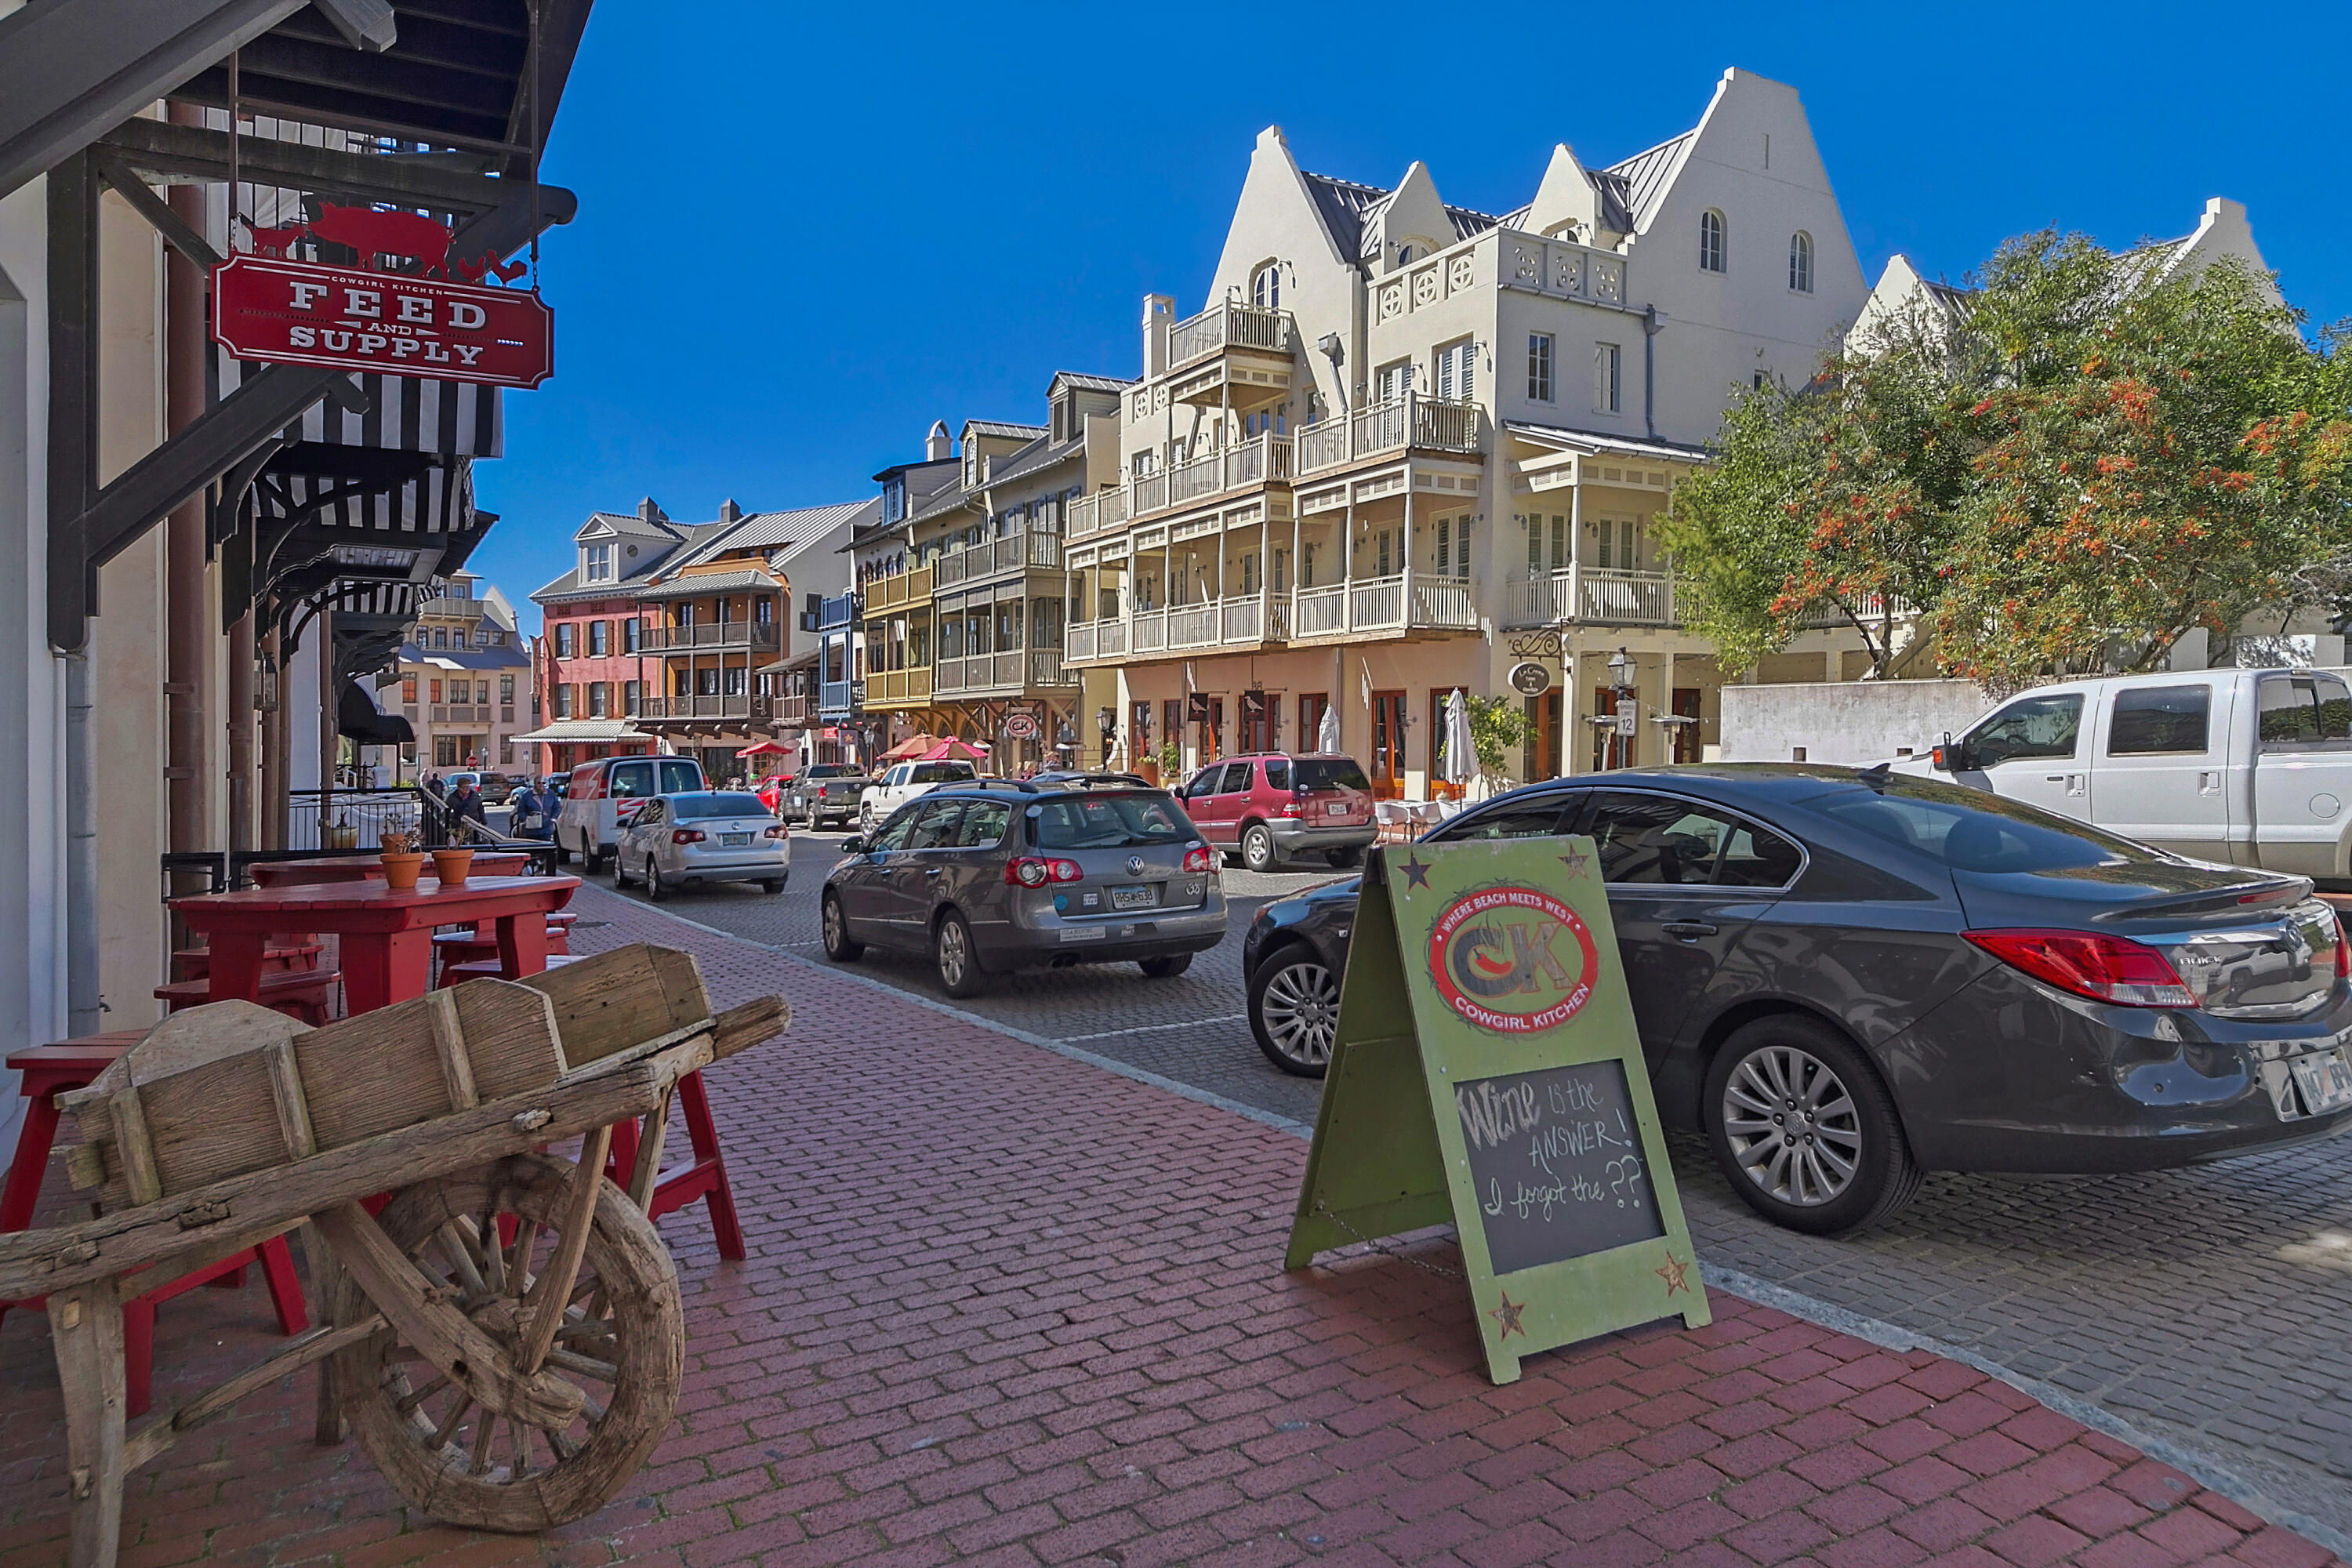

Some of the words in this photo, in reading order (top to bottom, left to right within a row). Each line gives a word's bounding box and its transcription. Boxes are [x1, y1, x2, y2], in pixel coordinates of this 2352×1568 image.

[289, 281, 486, 328] FEED
[332, 276, 386, 289] COWGIRL
[392, 284, 443, 296] KITCHEN
[289, 326, 484, 366] SUPPLY
[367, 322, 412, 336] AND
[1012, 720, 1029, 731] CK
[1621, 718, 1632, 730] 12
[1441, 901, 1474, 933] WHERE
[1473, 893, 1507, 909] BEACH
[1508, 892, 1542, 906] MEETS
[1545, 900, 1573, 924] WEST
[1454, 996, 1530, 1030] COWGIRL
[1532, 982, 1590, 1028] KITCHEN
[1457, 1080, 1541, 1151] Wine
[1548, 1079, 1566, 1115] is
[1566, 1078, 1604, 1112] the
[1484, 1177, 1504, 1215] I
[1510, 1175, 1566, 1222] forgot
[1571, 1174, 1605, 1202] the
